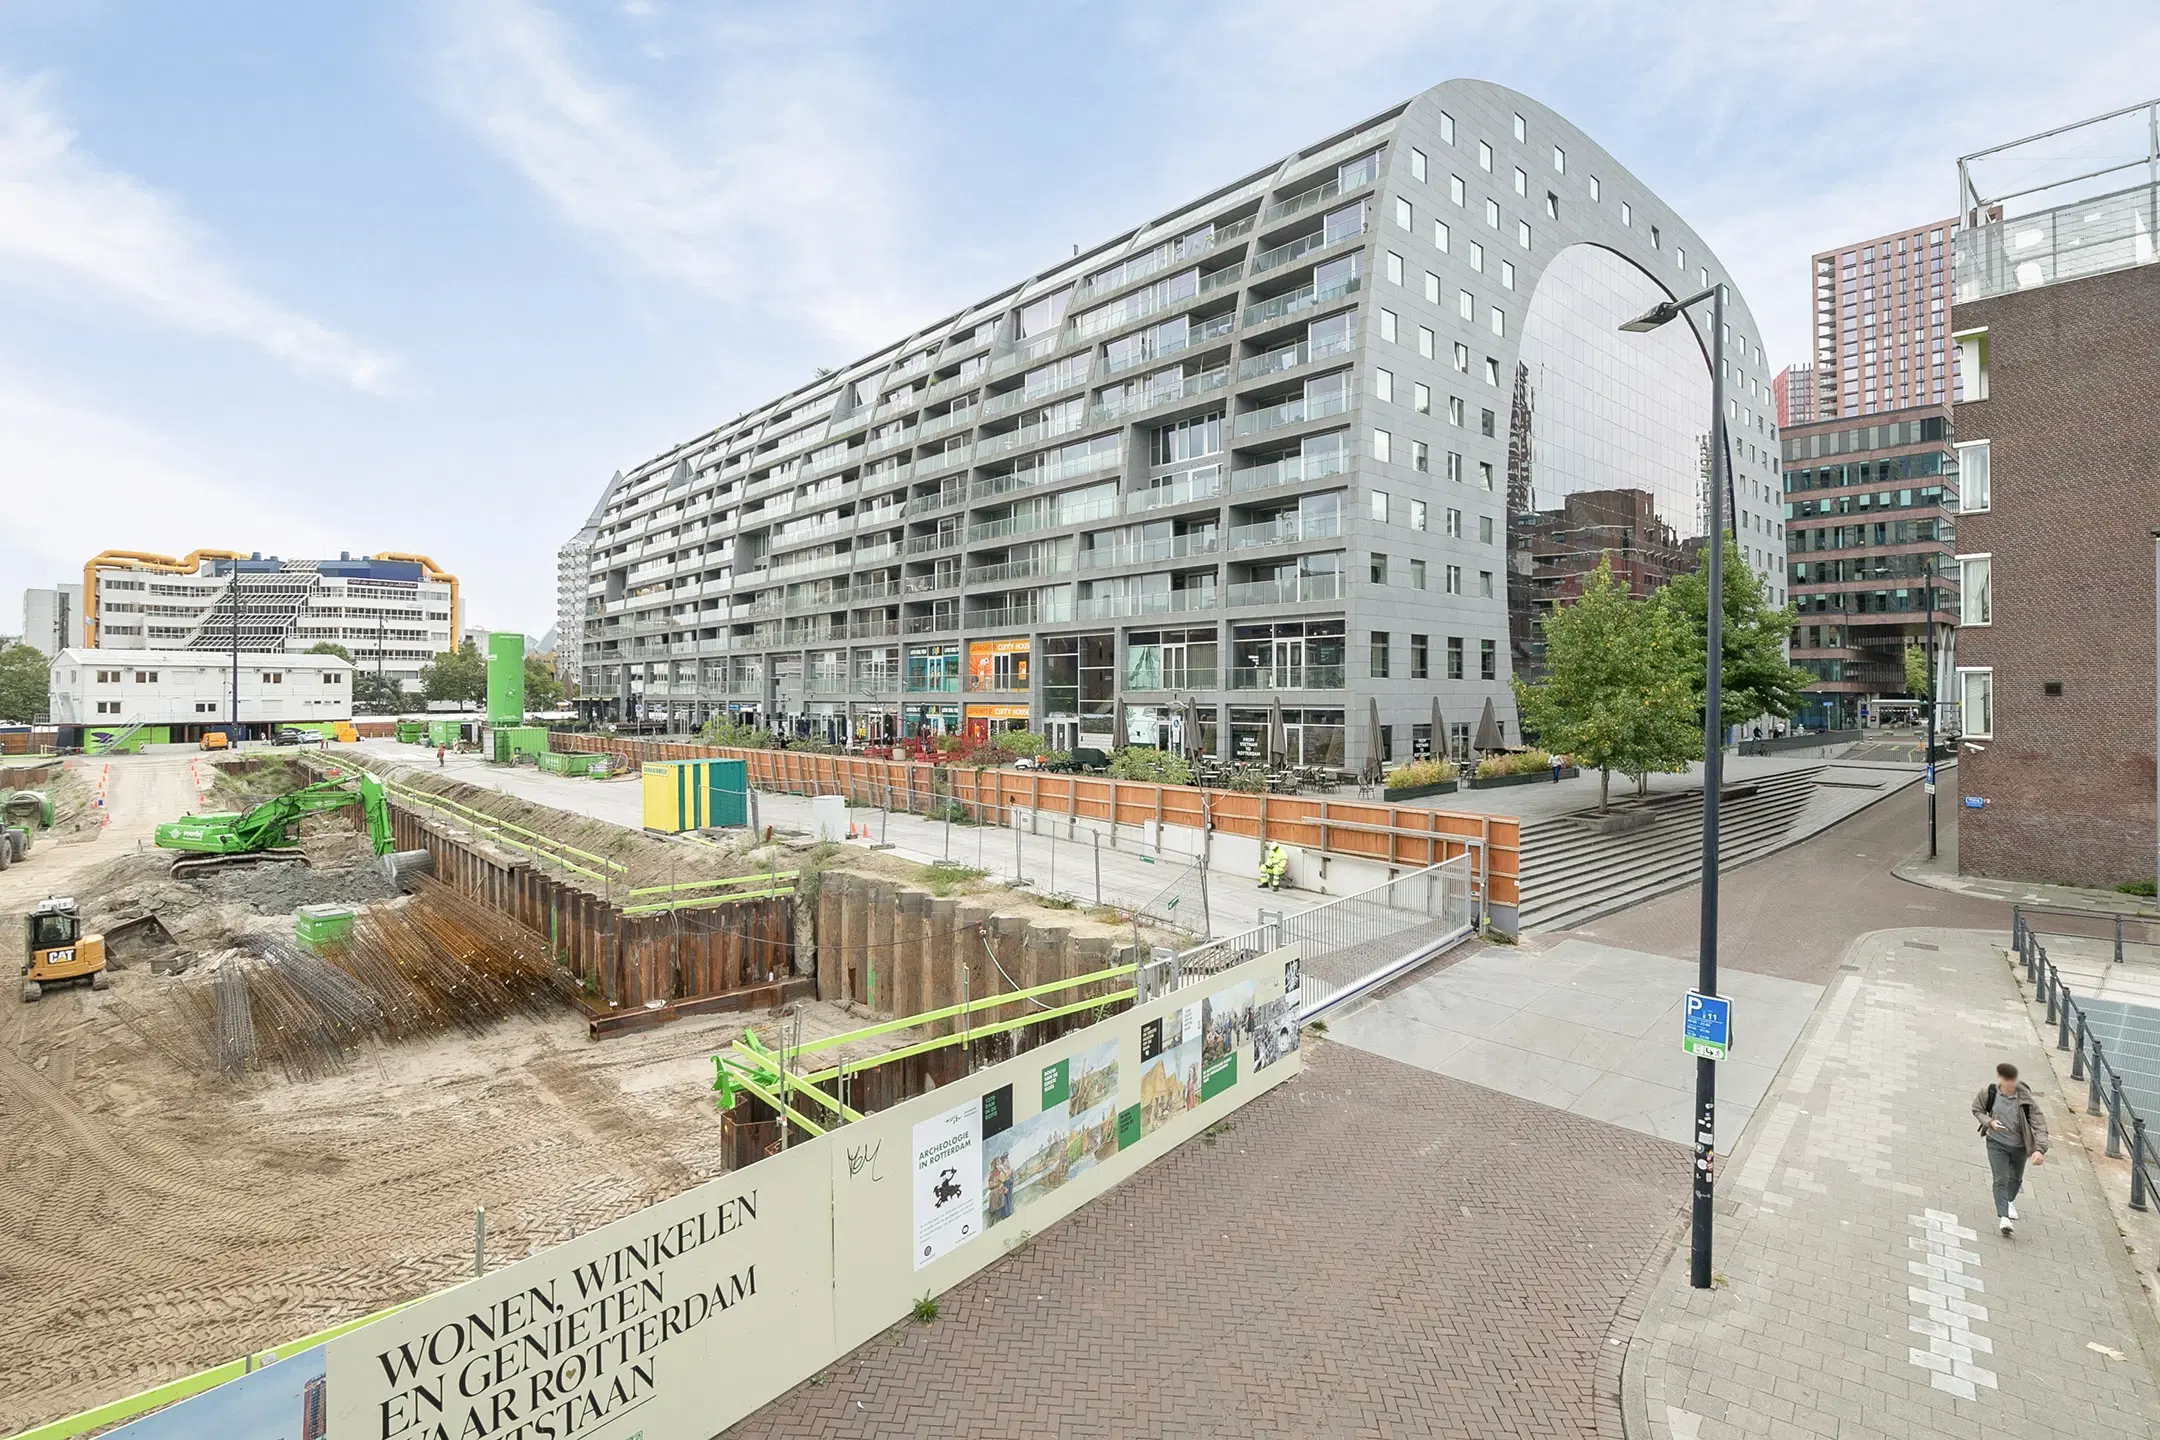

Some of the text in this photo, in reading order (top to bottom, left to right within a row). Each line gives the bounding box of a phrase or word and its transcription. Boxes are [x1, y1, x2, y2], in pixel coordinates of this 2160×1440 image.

[48, 950, 74, 963] CAT
[1688, 996, 1702, 1015] P
[919, 1131, 969, 1160] ARCHEOLOGIE
[919, 1139, 971, 1170] IN ROTTERDAM
[376, 1189, 757, 1388] WONEN, WINKELEN
[377, 1271, 664, 1440] EN GENIETEN
[406, 1263, 758, 1440] AAR ROTTERDAM
[497, 1355, 656, 1440] TSTAAN
